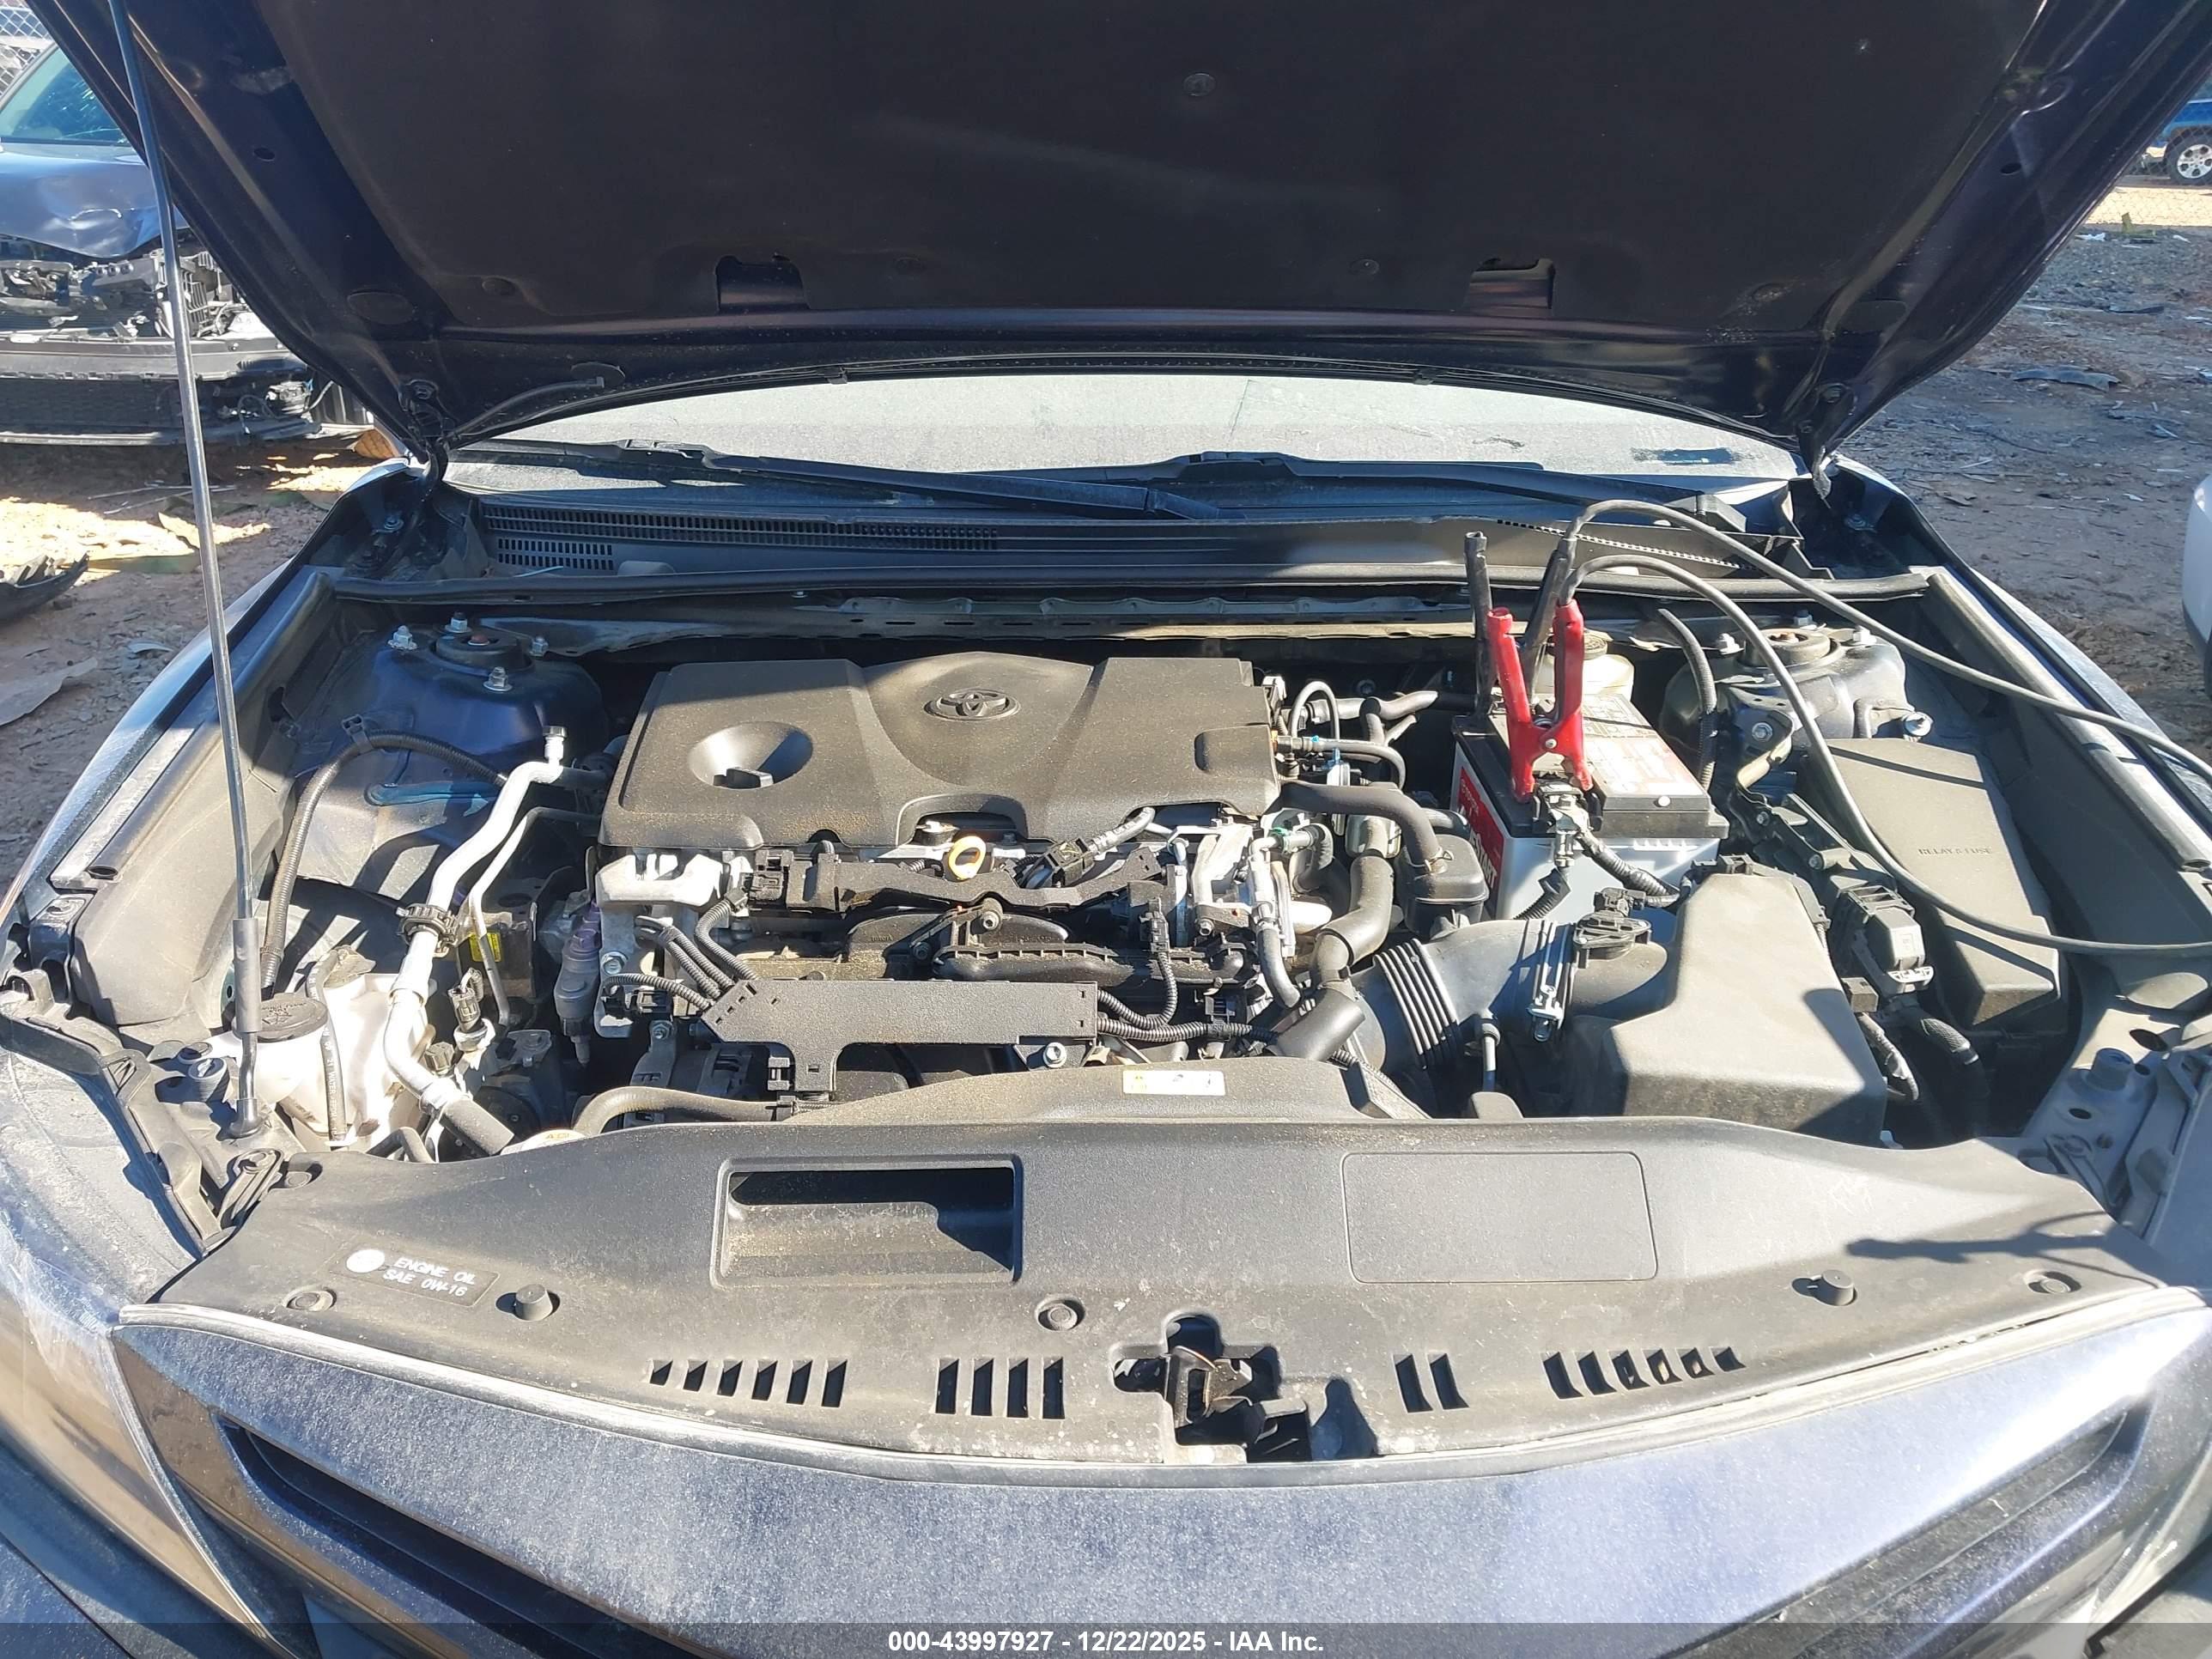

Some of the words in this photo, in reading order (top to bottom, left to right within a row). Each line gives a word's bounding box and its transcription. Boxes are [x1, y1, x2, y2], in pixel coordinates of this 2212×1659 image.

[383, 1269, 416, 1284] SAE
[421, 1279, 468, 1296] 0W-16
[393, 1257, 449, 1277] ENGINE
[453, 1272, 476, 1285] OIL
